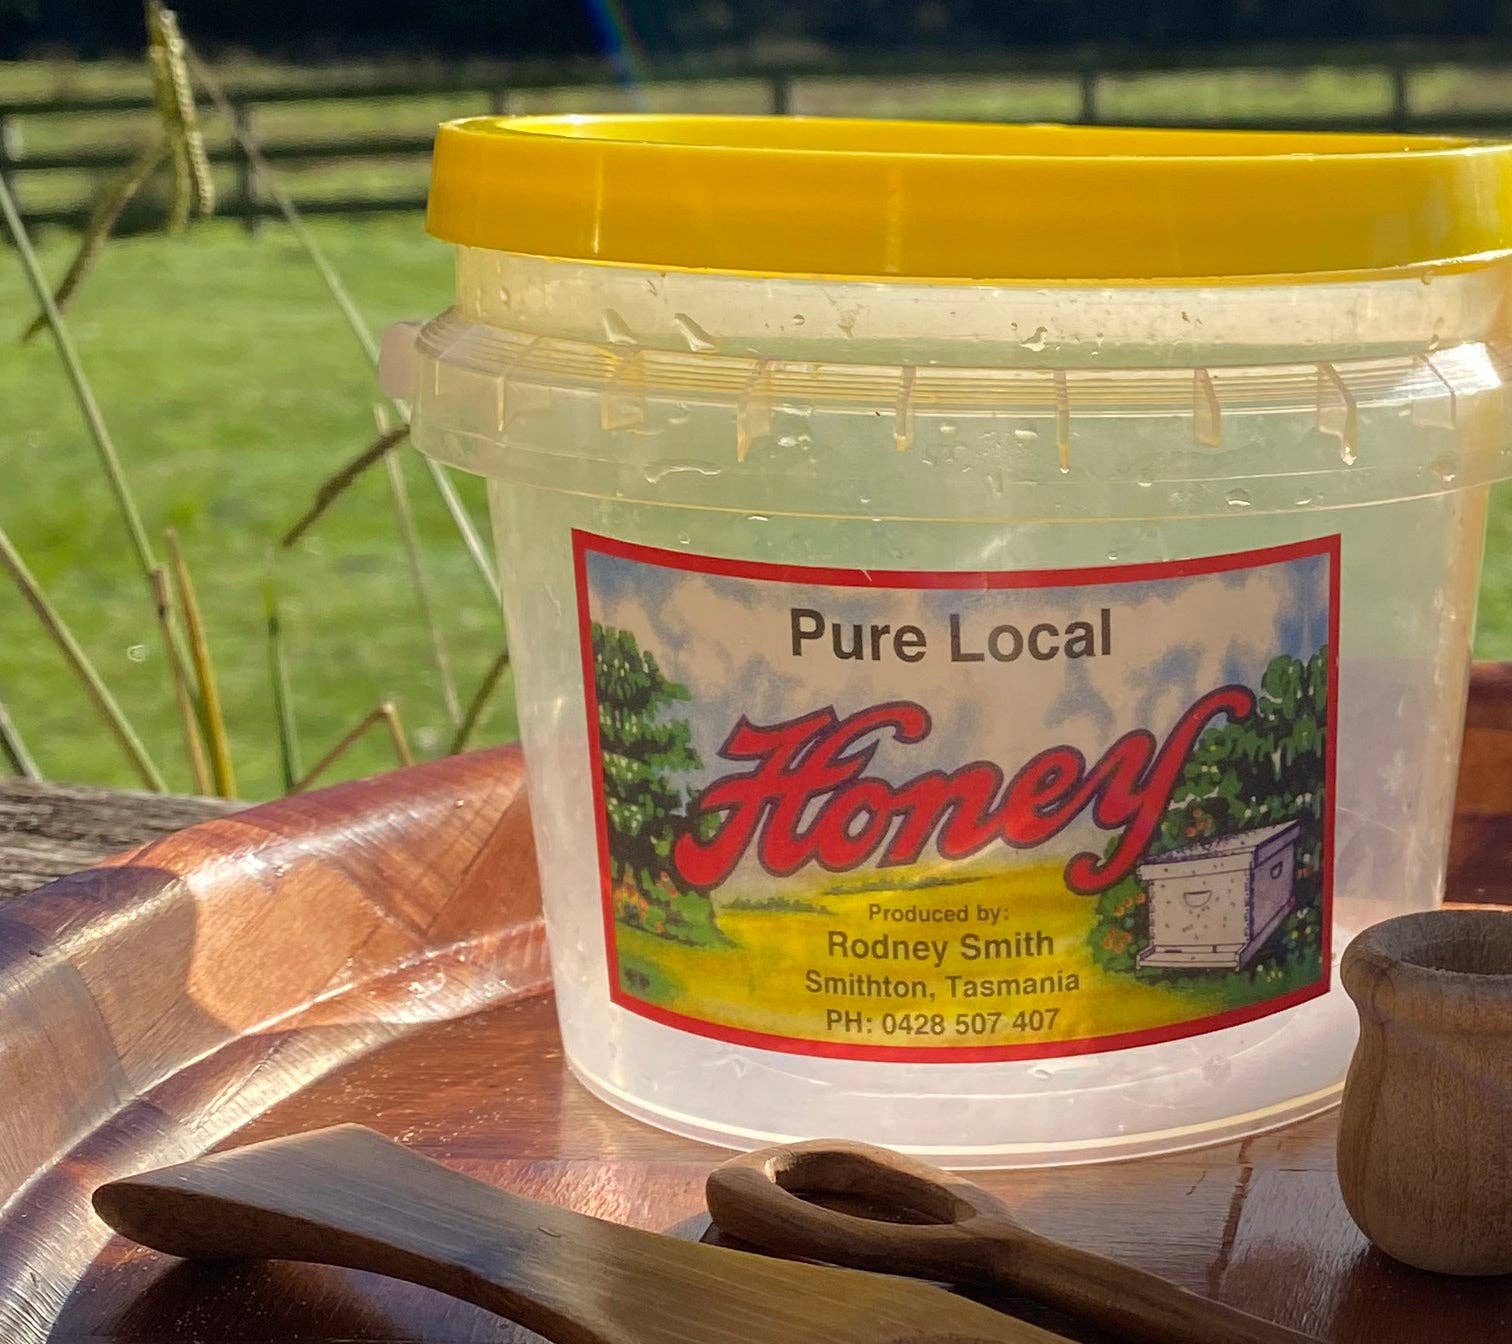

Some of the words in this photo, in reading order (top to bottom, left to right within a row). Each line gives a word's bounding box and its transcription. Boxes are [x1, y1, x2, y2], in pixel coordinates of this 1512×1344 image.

[790, 607, 927, 663] Pure
[950, 607, 1111, 663] Local
[673, 684, 1257, 895] Honey
[868, 903, 968, 923] Produced
[976, 904, 1010, 926] by:
[827, 930, 948, 968] Rodney
[960, 931, 1055, 961] Smith
[805, 969, 936, 1002] Smithton,
[945, 970, 1080, 998] Tasmania
[826, 1008, 873, 1034] PH:
[882, 1012, 945, 1035] 0428
[955, 1011, 1003, 1035] 507
[1012, 1008, 1061, 1032] 407
